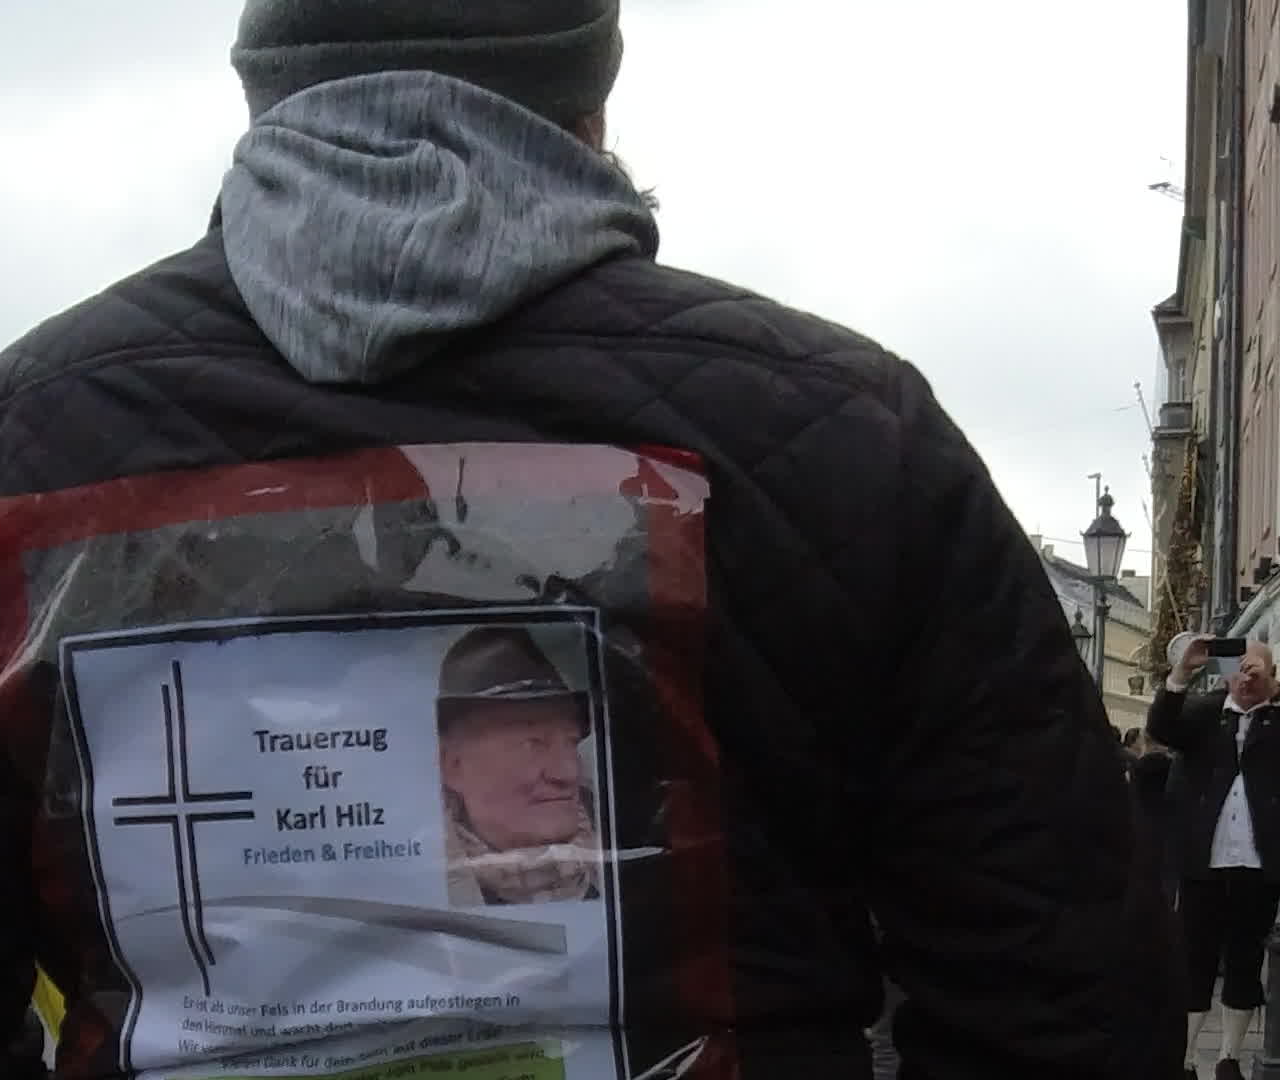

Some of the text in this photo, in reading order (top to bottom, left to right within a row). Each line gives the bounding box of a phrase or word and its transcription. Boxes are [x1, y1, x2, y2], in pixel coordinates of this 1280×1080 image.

[254, 728, 389, 753] Trauerzug
[302, 765, 343, 790] für
[276, 802, 385, 833] Karl Hilz
[243, 837, 422, 865] Frieden & Freiheit
[260, 1002, 289, 1016] Fels
[293, 1000, 306, 1015] in
[309, 1000, 333, 1014] der
[336, 996, 402, 1014] Brandung
[407, 993, 503, 1013] aufgestiegen
[506, 992, 521, 1008] in
